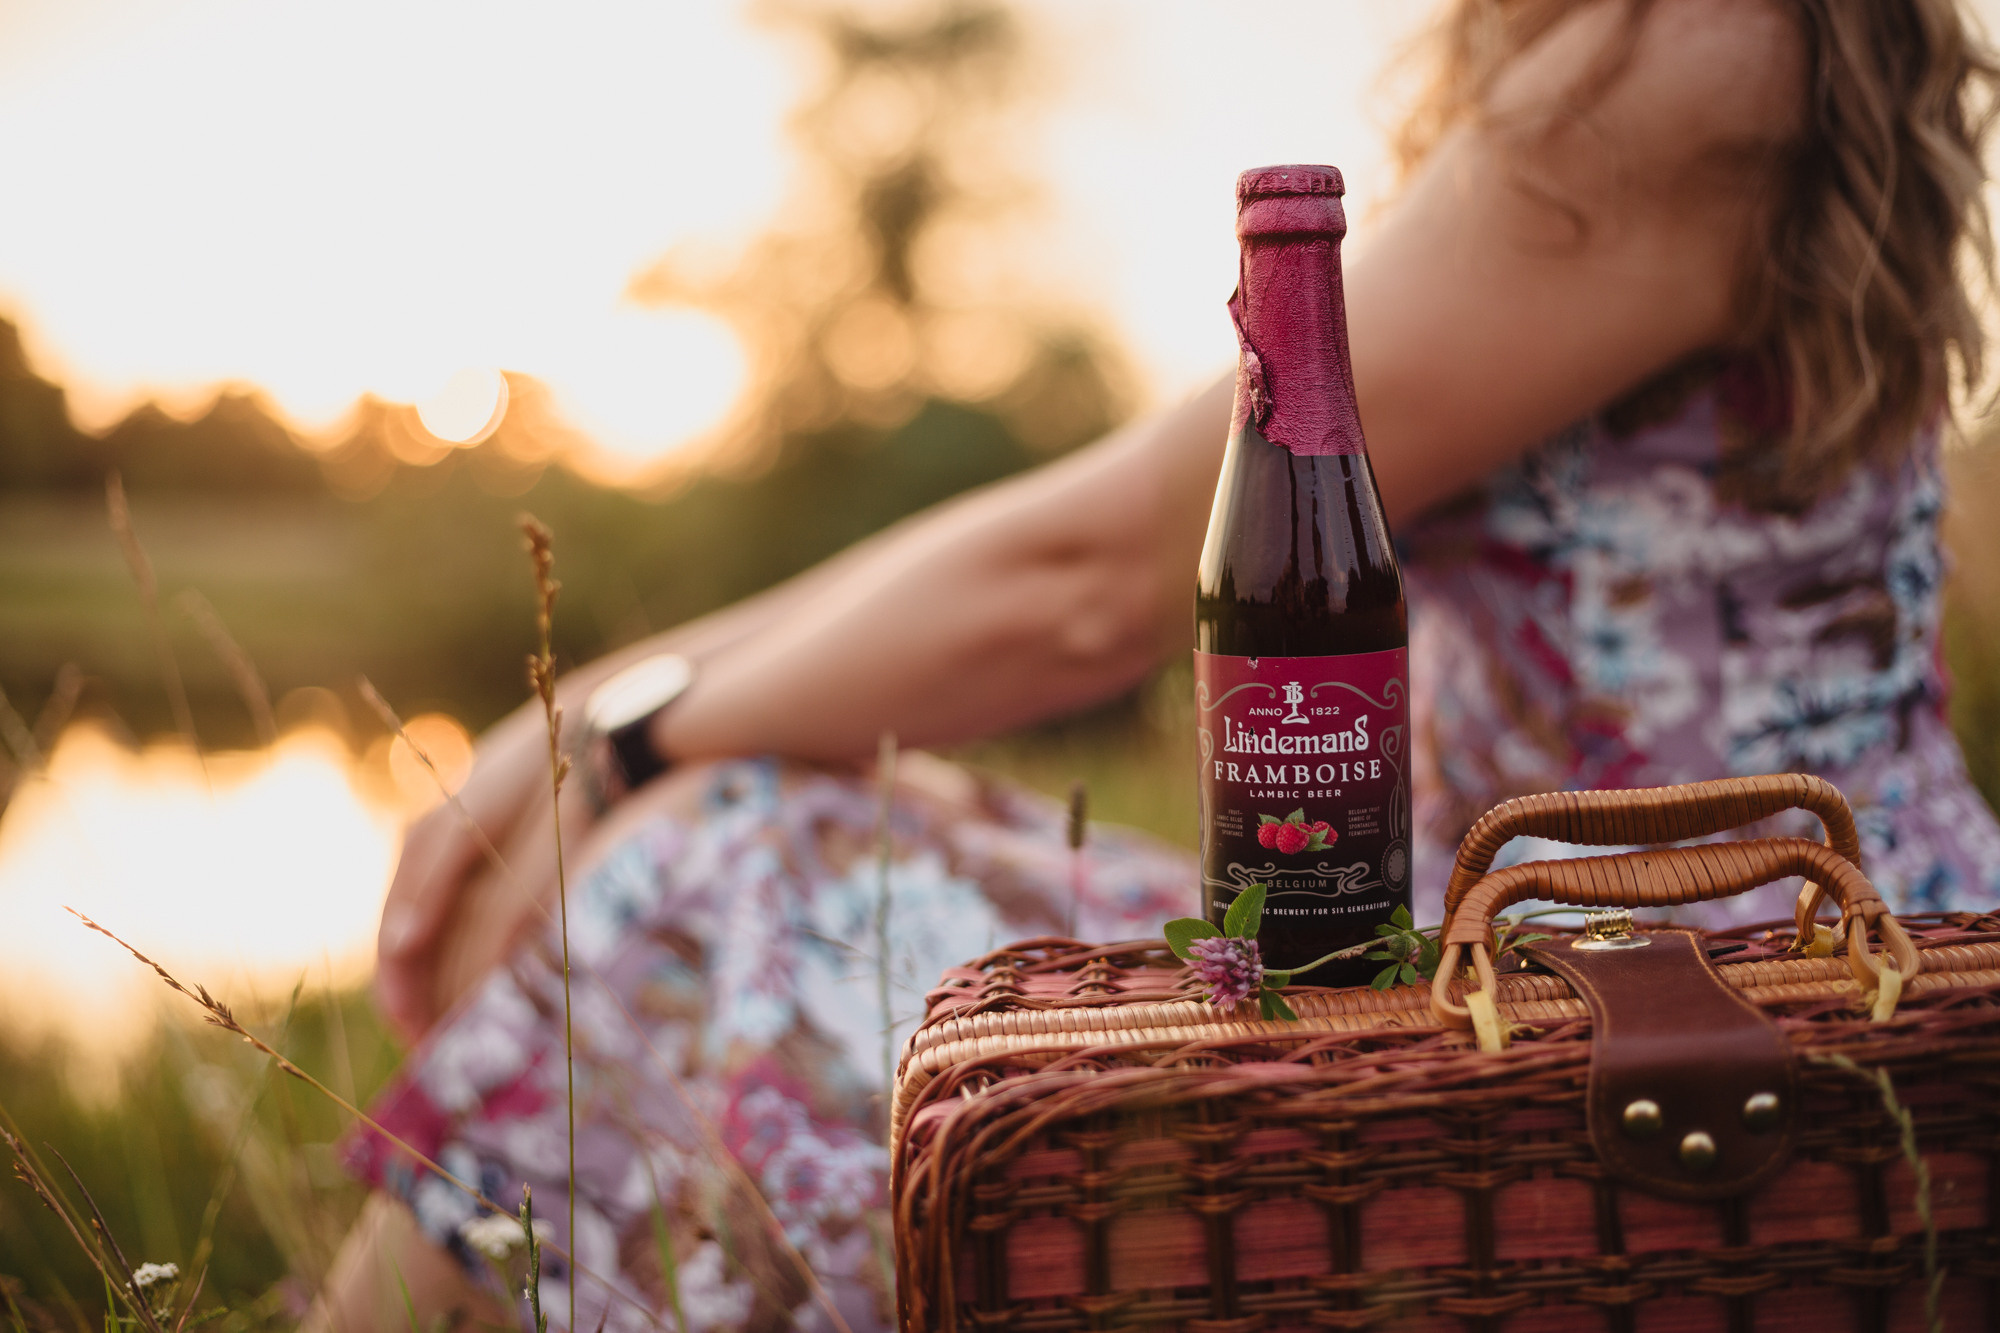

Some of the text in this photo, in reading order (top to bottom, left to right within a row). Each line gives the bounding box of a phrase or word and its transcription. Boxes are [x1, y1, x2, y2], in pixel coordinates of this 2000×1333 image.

[1248, 706, 1340, 717] ANNO 1822
[1214, 759, 1382, 785] FRAMBOISE
[1249, 788, 1342, 799] LAMBIC BEER
[1267, 879, 1328, 889] BELGIUM
[1273, 907, 1310, 916] BREWERY
[1313, 907, 1328, 915] FOR
[1347, 900, 1391, 913] GENERATIONS
